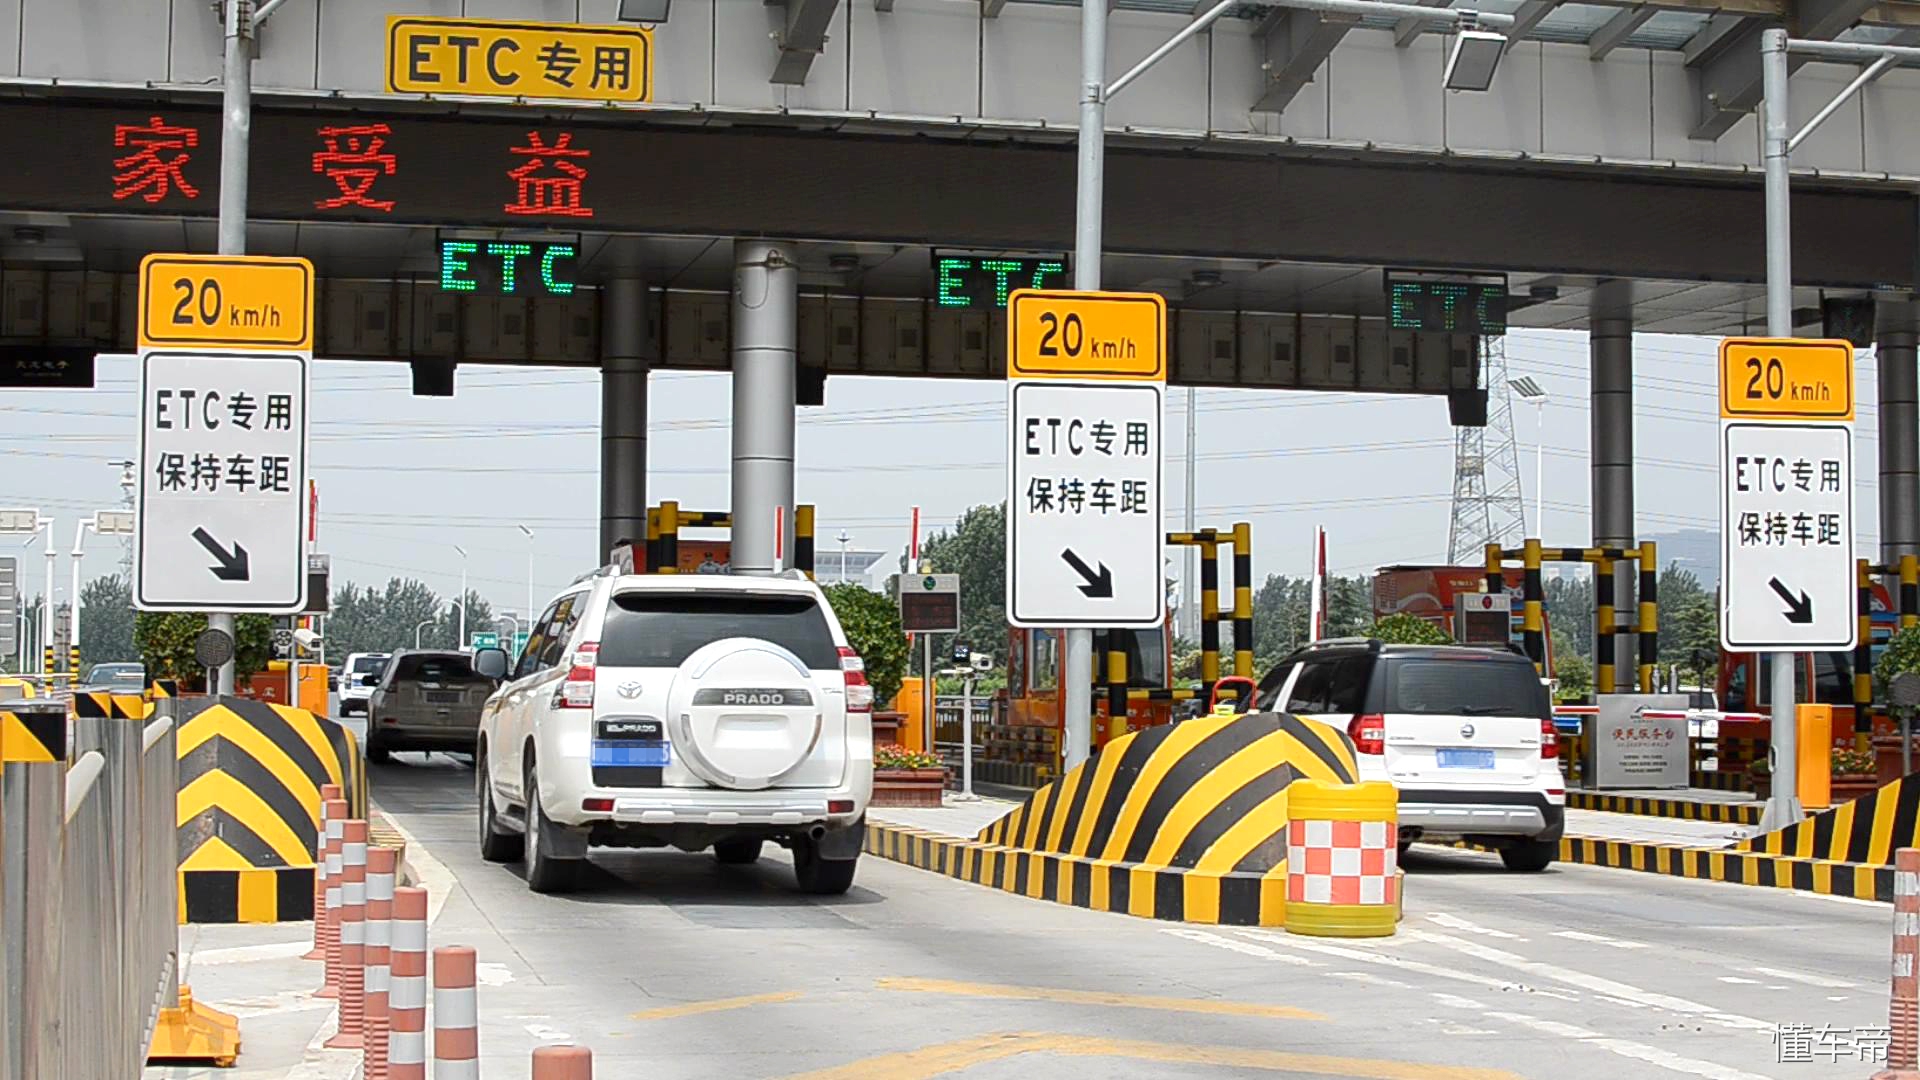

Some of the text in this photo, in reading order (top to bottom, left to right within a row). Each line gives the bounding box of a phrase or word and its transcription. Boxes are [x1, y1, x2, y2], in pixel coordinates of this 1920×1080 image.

[408, 35, 631, 90] ETC 专用
[441, 241, 575, 295] ETC
[172, 278, 281, 328] 20 km/h
[1391, 283, 1507, 332] ETC
[1039, 311, 1137, 360] 20 km/h
[1745, 357, 1831, 402] 20 km/h
[156, 452, 291, 493] 保持车距
[1027, 477, 1148, 514] 保持车距
[1738, 512, 1841, 546] 保持车距
[723, 693, 785, 705] PRADO
